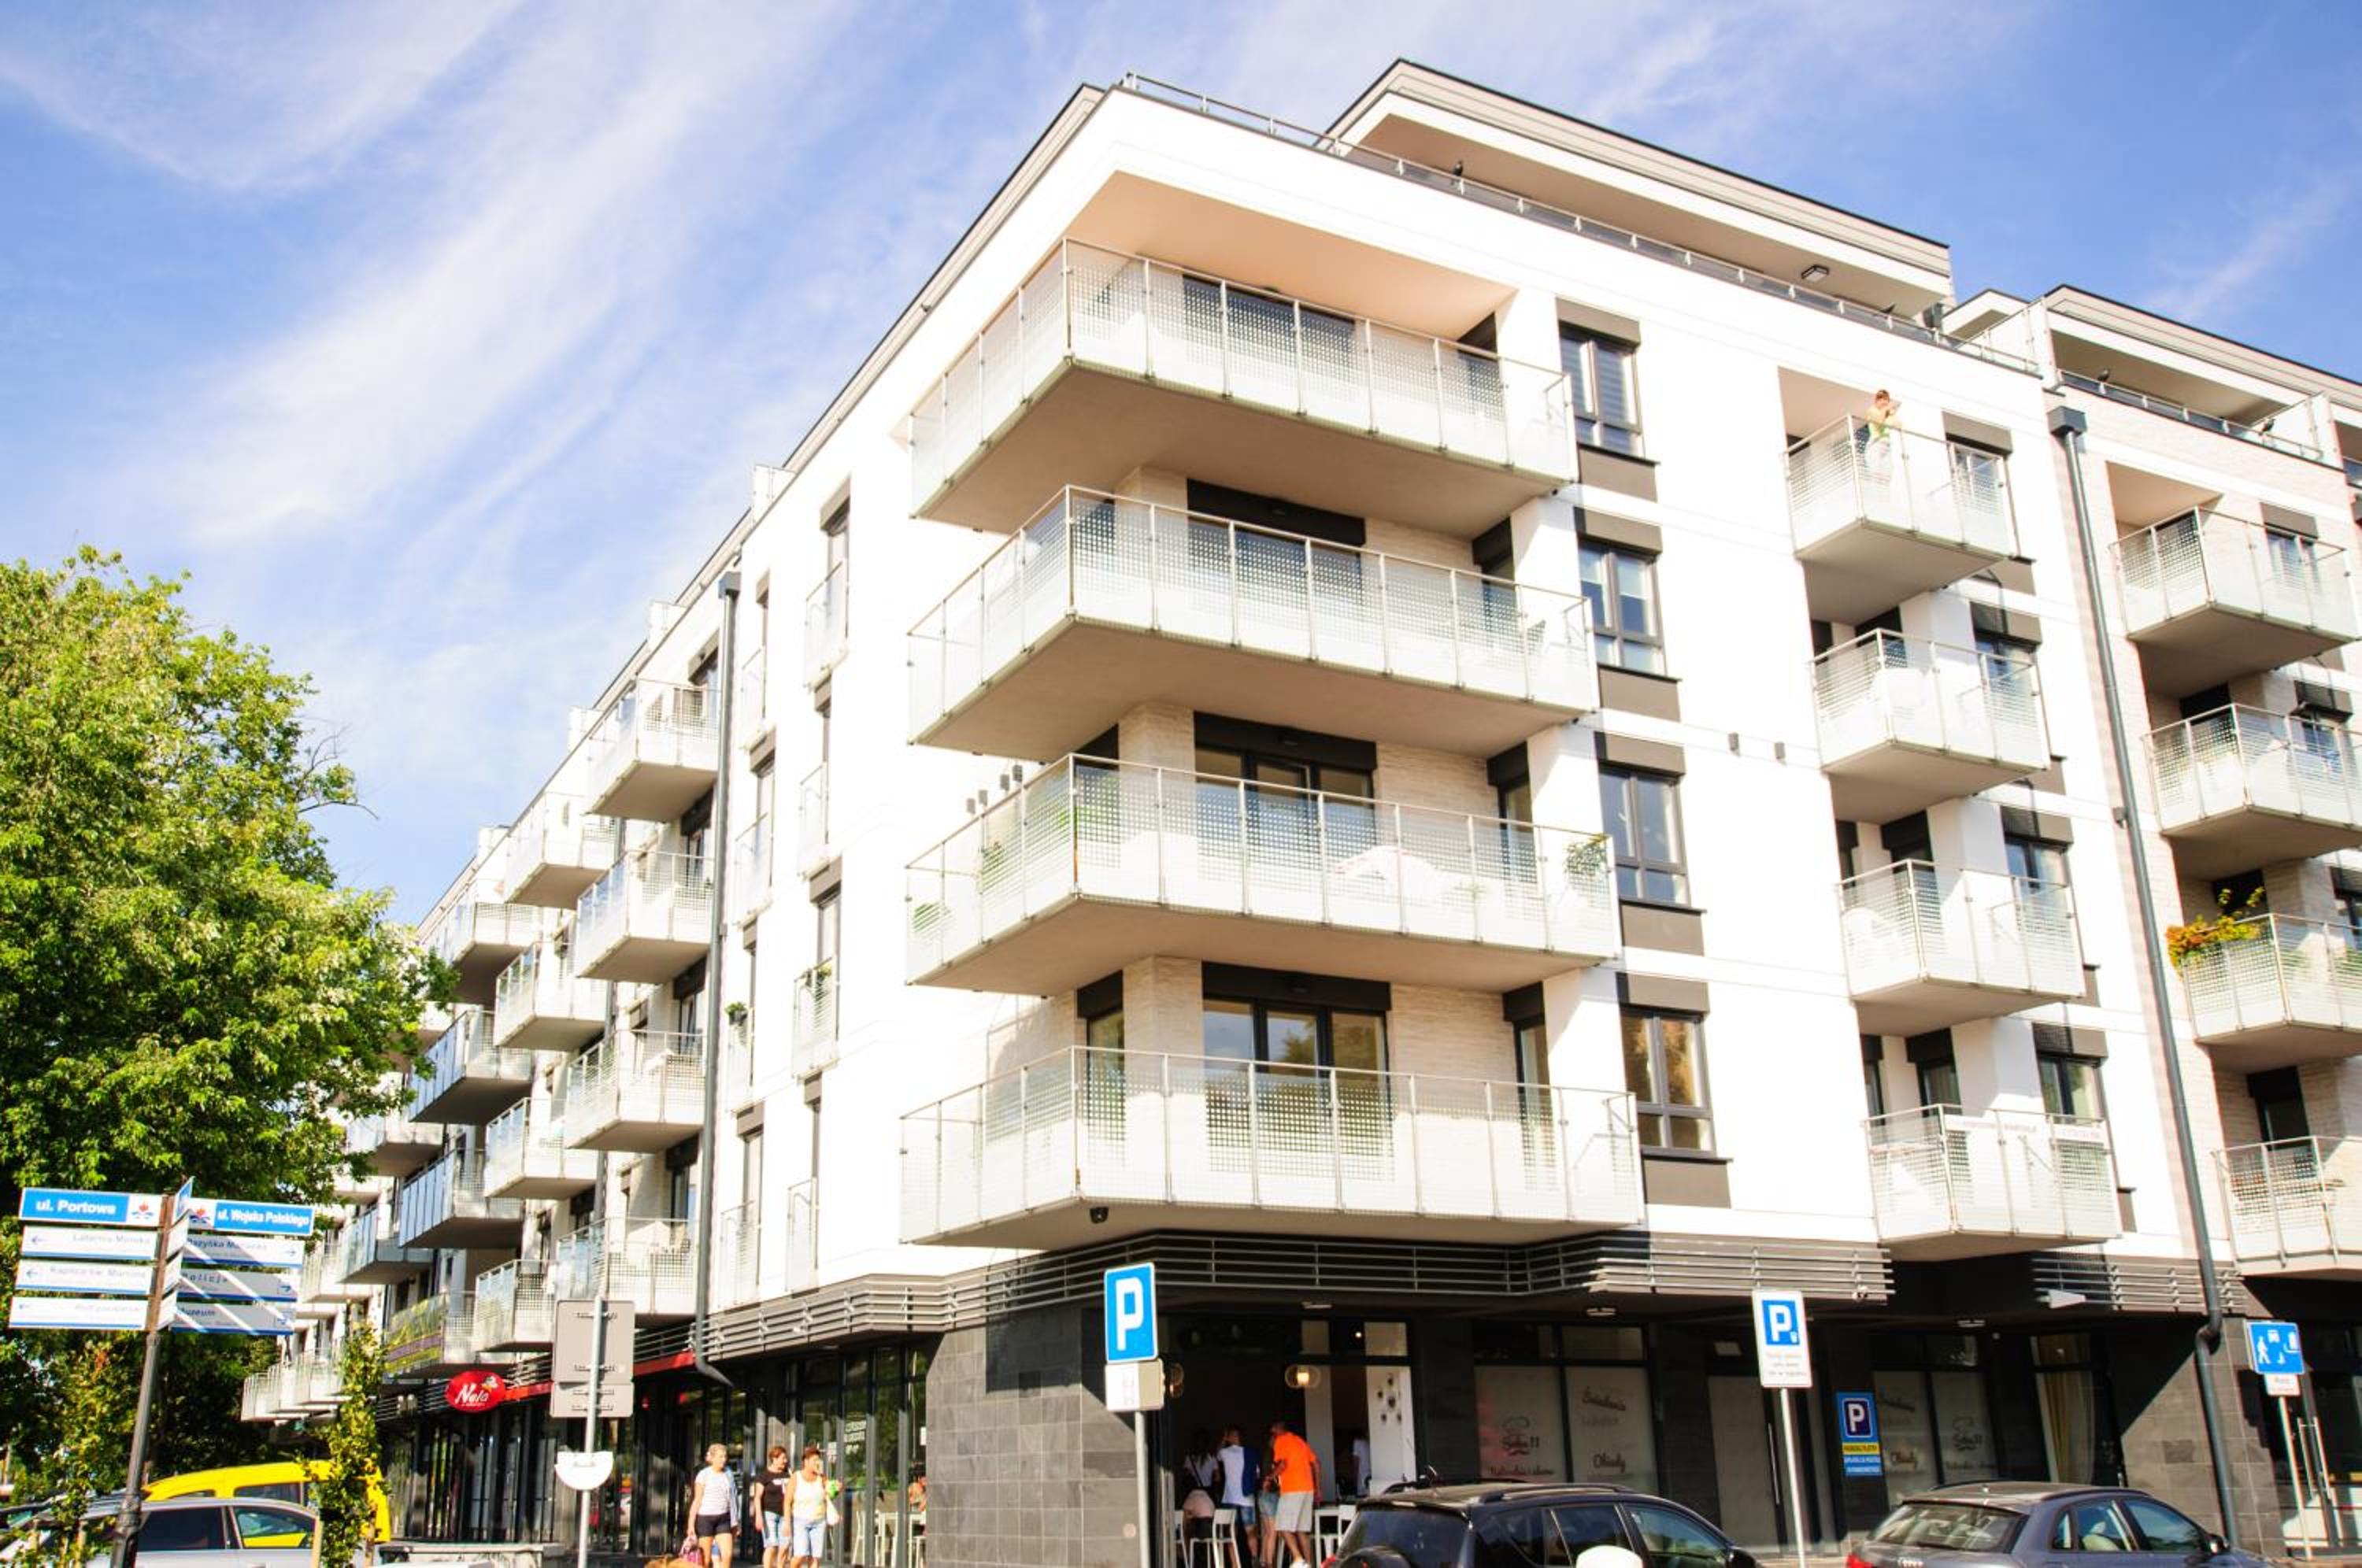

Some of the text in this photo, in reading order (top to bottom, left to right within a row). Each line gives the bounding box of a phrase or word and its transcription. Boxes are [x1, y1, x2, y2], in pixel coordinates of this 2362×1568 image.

[36, 1198, 117, 1215] ul. Portowa
[217, 1209, 309, 1228] ul. Wojska Polskiego
[1116, 1277, 1144, 1351] P
[1768, 1304, 1792, 1342] P
[1848, 1403, 1865, 1433] P
